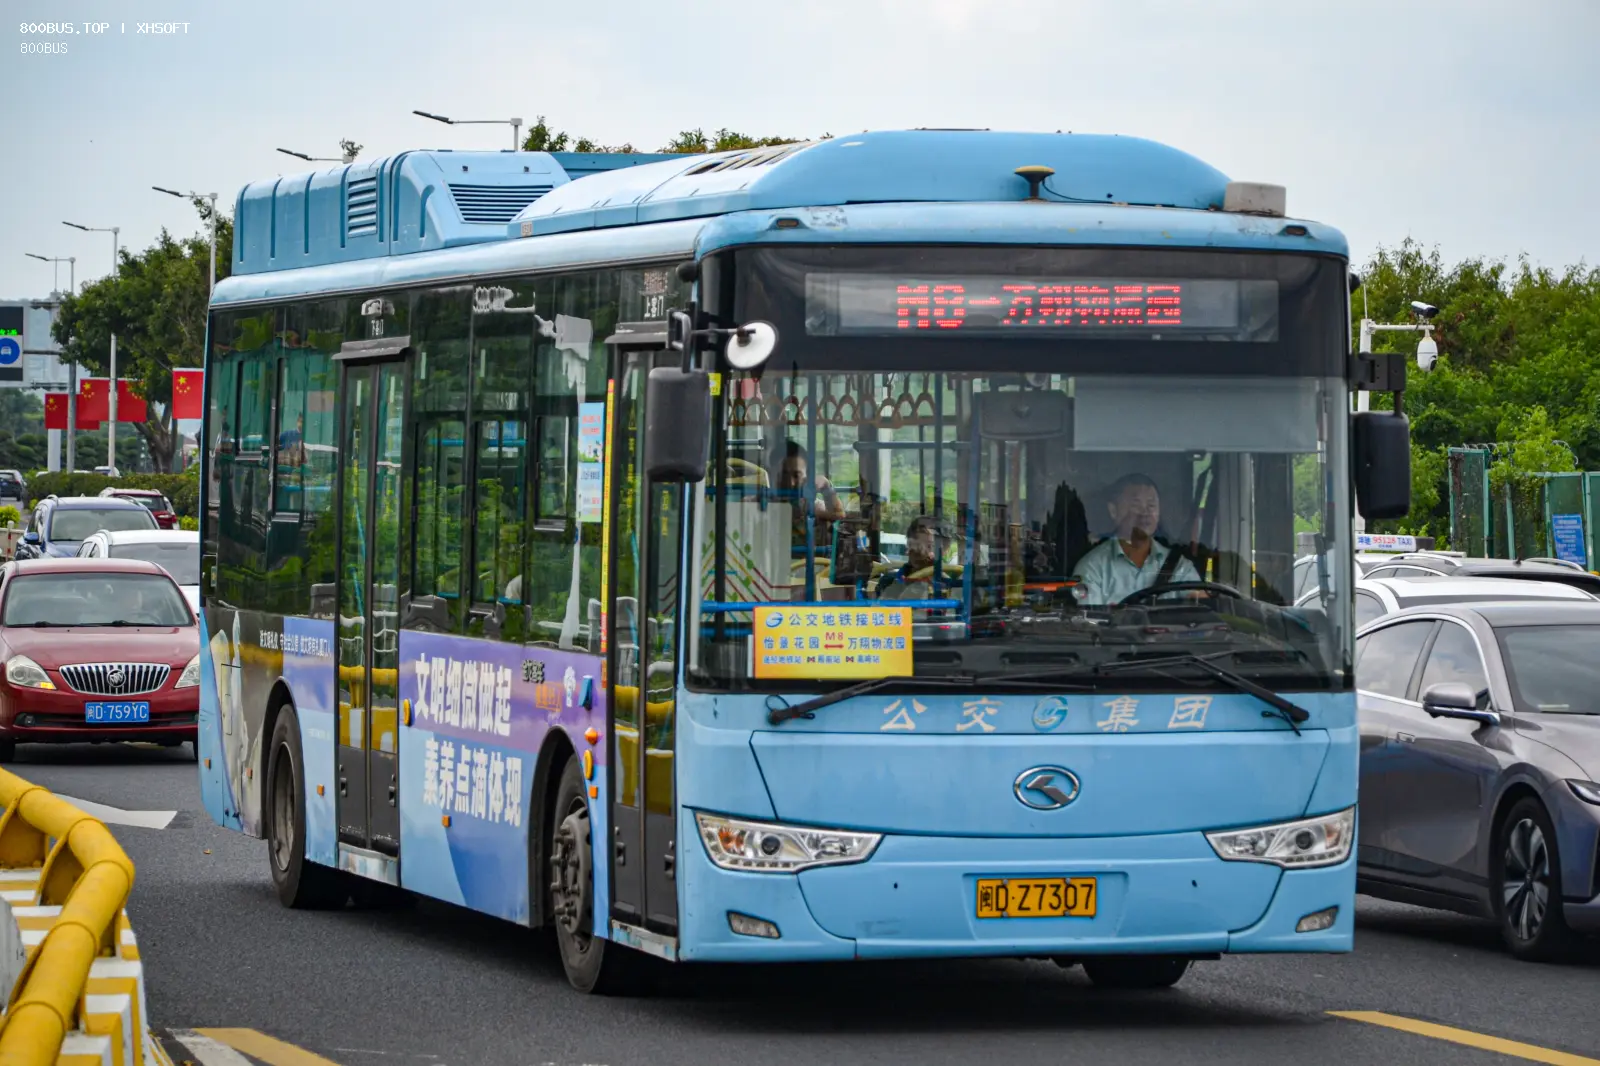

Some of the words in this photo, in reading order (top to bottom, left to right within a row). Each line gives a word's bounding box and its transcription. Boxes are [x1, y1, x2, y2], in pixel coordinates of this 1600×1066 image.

[1372, 536, 1397, 544] 95128
[1397, 537, 1413, 546] TAXI
[788, 612, 903, 627] 公交地铁接驳线
[825, 631, 844, 641] M8
[414, 652, 512, 737] 文明细微做起
[423, 738, 523, 828] 素养点滴体现
